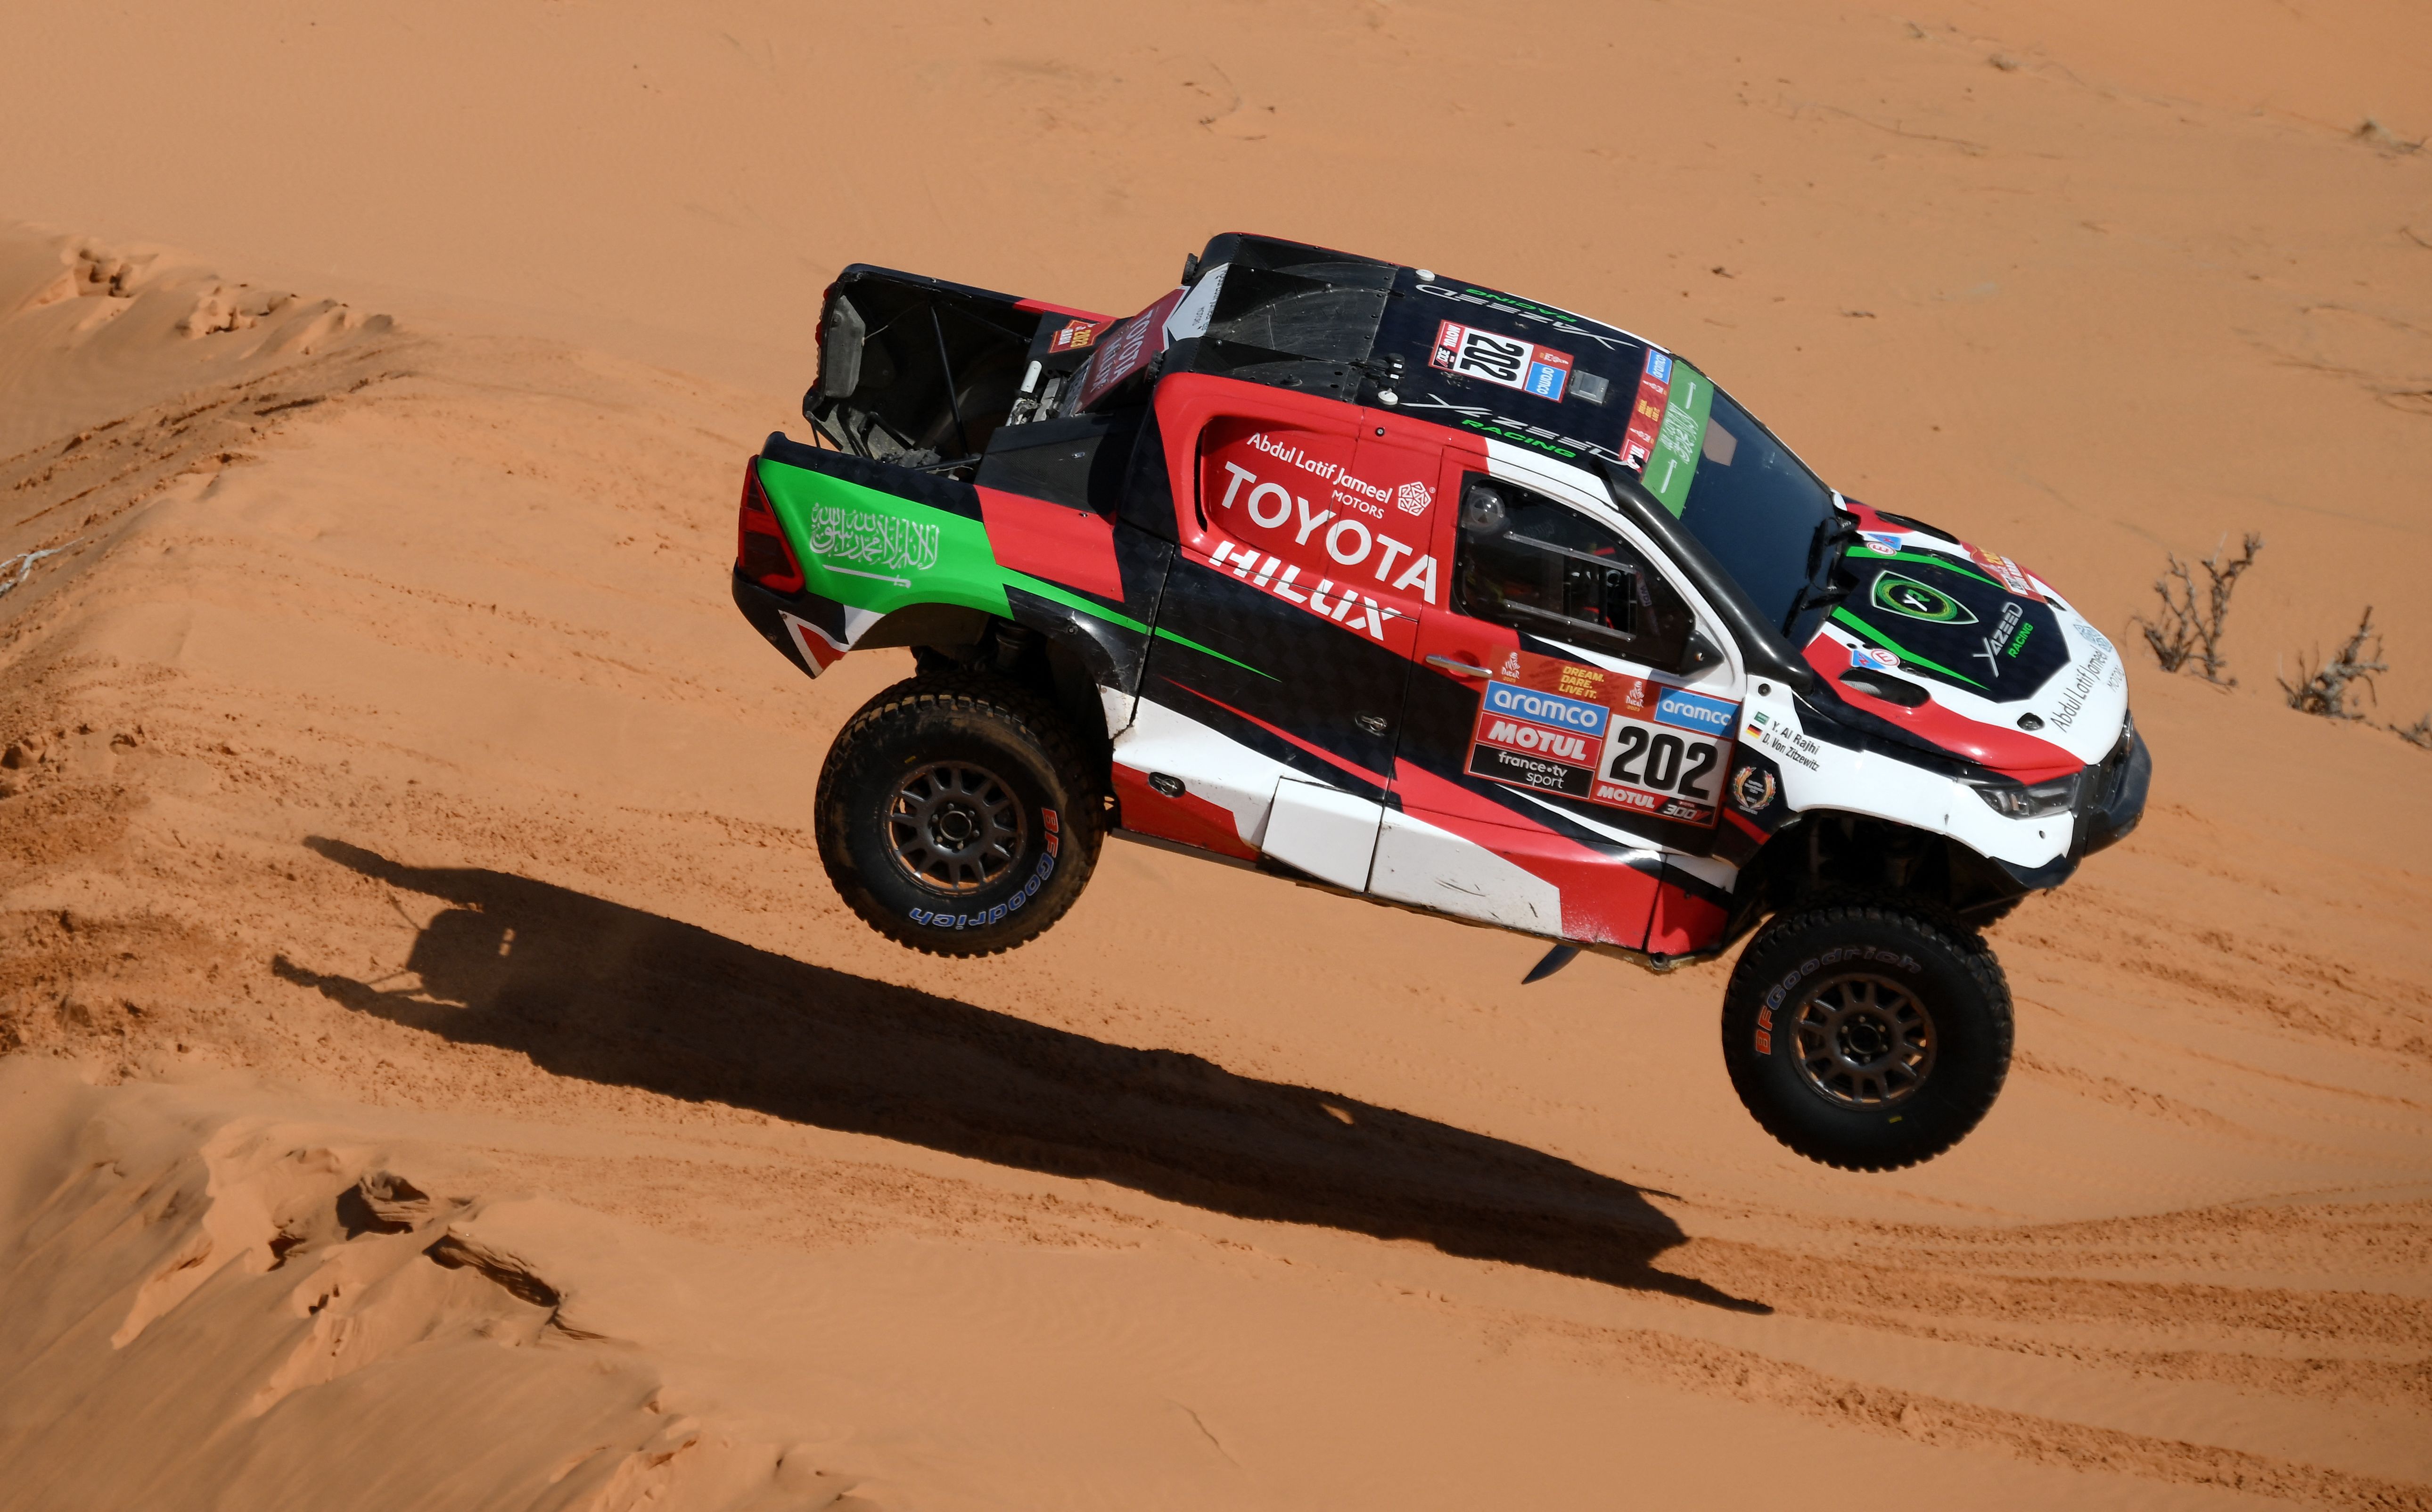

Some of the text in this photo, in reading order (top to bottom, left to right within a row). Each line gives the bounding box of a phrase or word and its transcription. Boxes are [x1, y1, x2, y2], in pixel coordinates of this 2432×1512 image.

[1465, 288, 1578, 323] RACING
[1070, 329, 1091, 348] 2023
[1111, 309, 1154, 383] TOYOTA
[1442, 324, 1461, 347] MOTUL
[1459, 333, 1525, 382] 202
[1653, 354, 1666, 378] aramco
[1536, 367, 1555, 395] aramco
[1462, 419, 1576, 458] RACING
[1247, 432, 1393, 504] Abdul Latif Jameel
[1332, 490, 1385, 519] MOTORS
[1222, 461, 1437, 605] TOYOTA
[1208, 540, 1402, 641] HILUX
[1972, 602, 2023, 678] YAZEED
[2007, 622, 2034, 658] RACING
[1559, 684, 1597, 699] LIVE IT.
[1561, 675, 1593, 689] DARE.
[1563, 666, 1604, 682] DREAM.
[2050, 644, 2109, 733] Abdul Latif Jameel
[1494, 690, 1598, 728] aramco
[1662, 700, 1733, 726] aramco
[1488, 721, 1587, 761] MOTUL
[1762, 733, 1820, 772] D. Von Zitzewitz
[1771, 721, 1821, 756] Y. Al Rajhi
[1526, 772, 1565, 789] sport
[1609, 726, 1718, 801] 202
[1597, 785, 1656, 809] MOTUL
[910, 807, 1059, 930] BFGoodrich
[1755, 946, 1922, 1055] BFGoodrich
